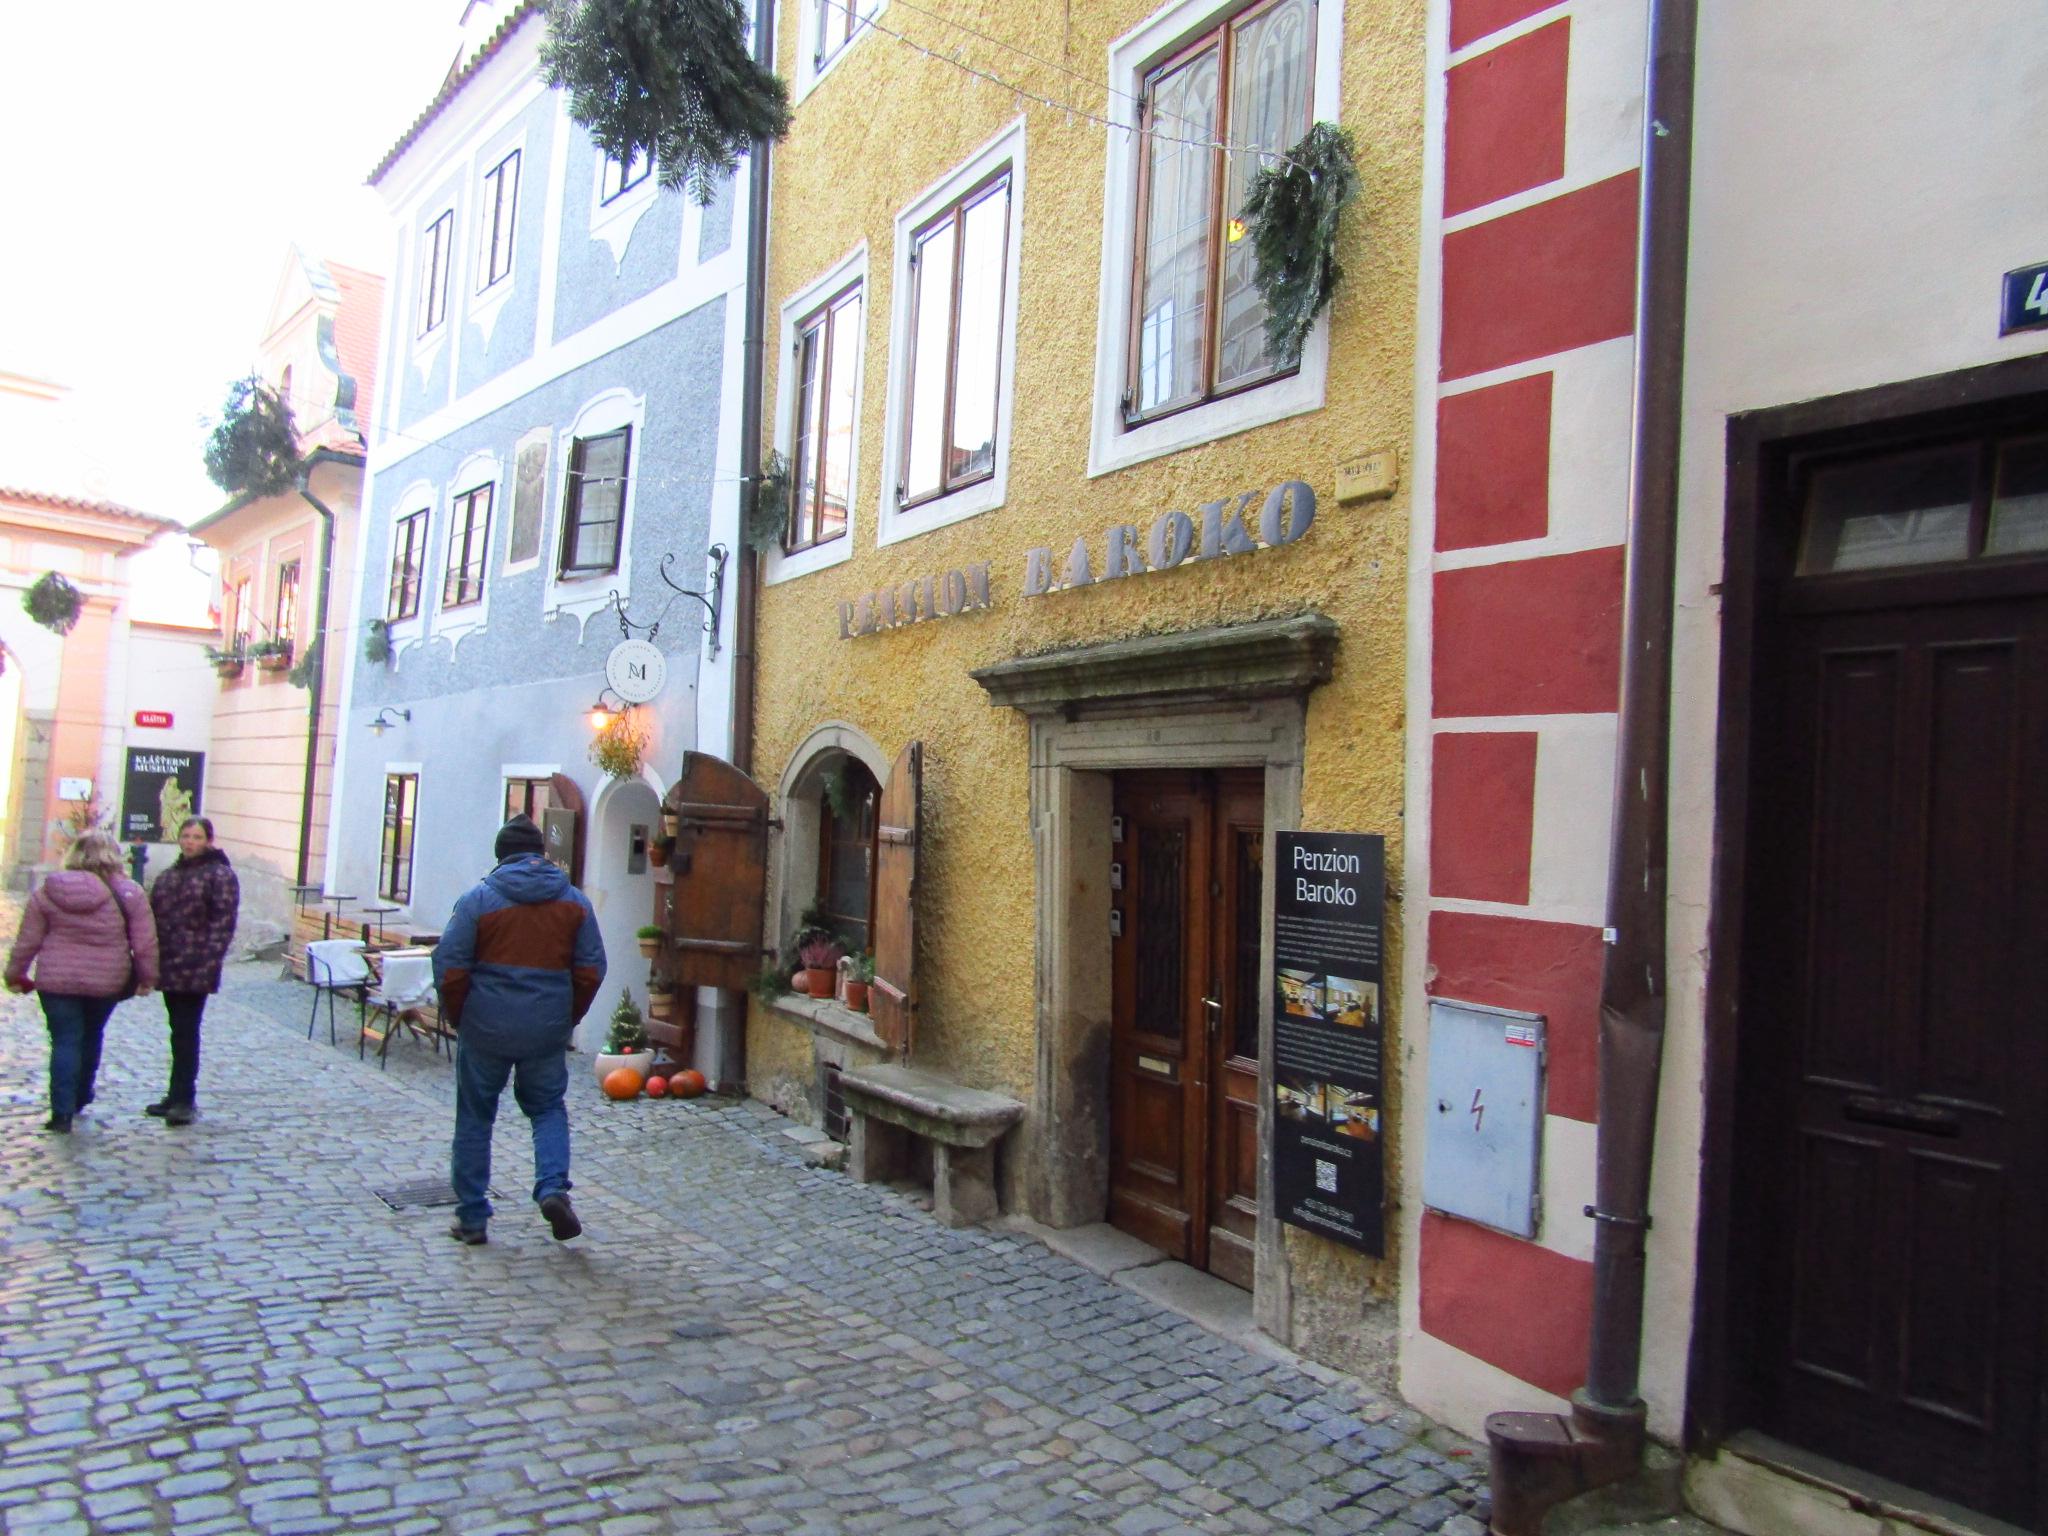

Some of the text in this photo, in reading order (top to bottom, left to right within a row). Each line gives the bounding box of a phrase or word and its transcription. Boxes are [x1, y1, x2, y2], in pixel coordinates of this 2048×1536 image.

[837, 480, 1316, 640] PENSION BAROKO
[135, 764, 179, 774] MUSEUM
[1293, 846, 1360, 873] Penzion
[1296, 877, 1357, 906] Baroko
